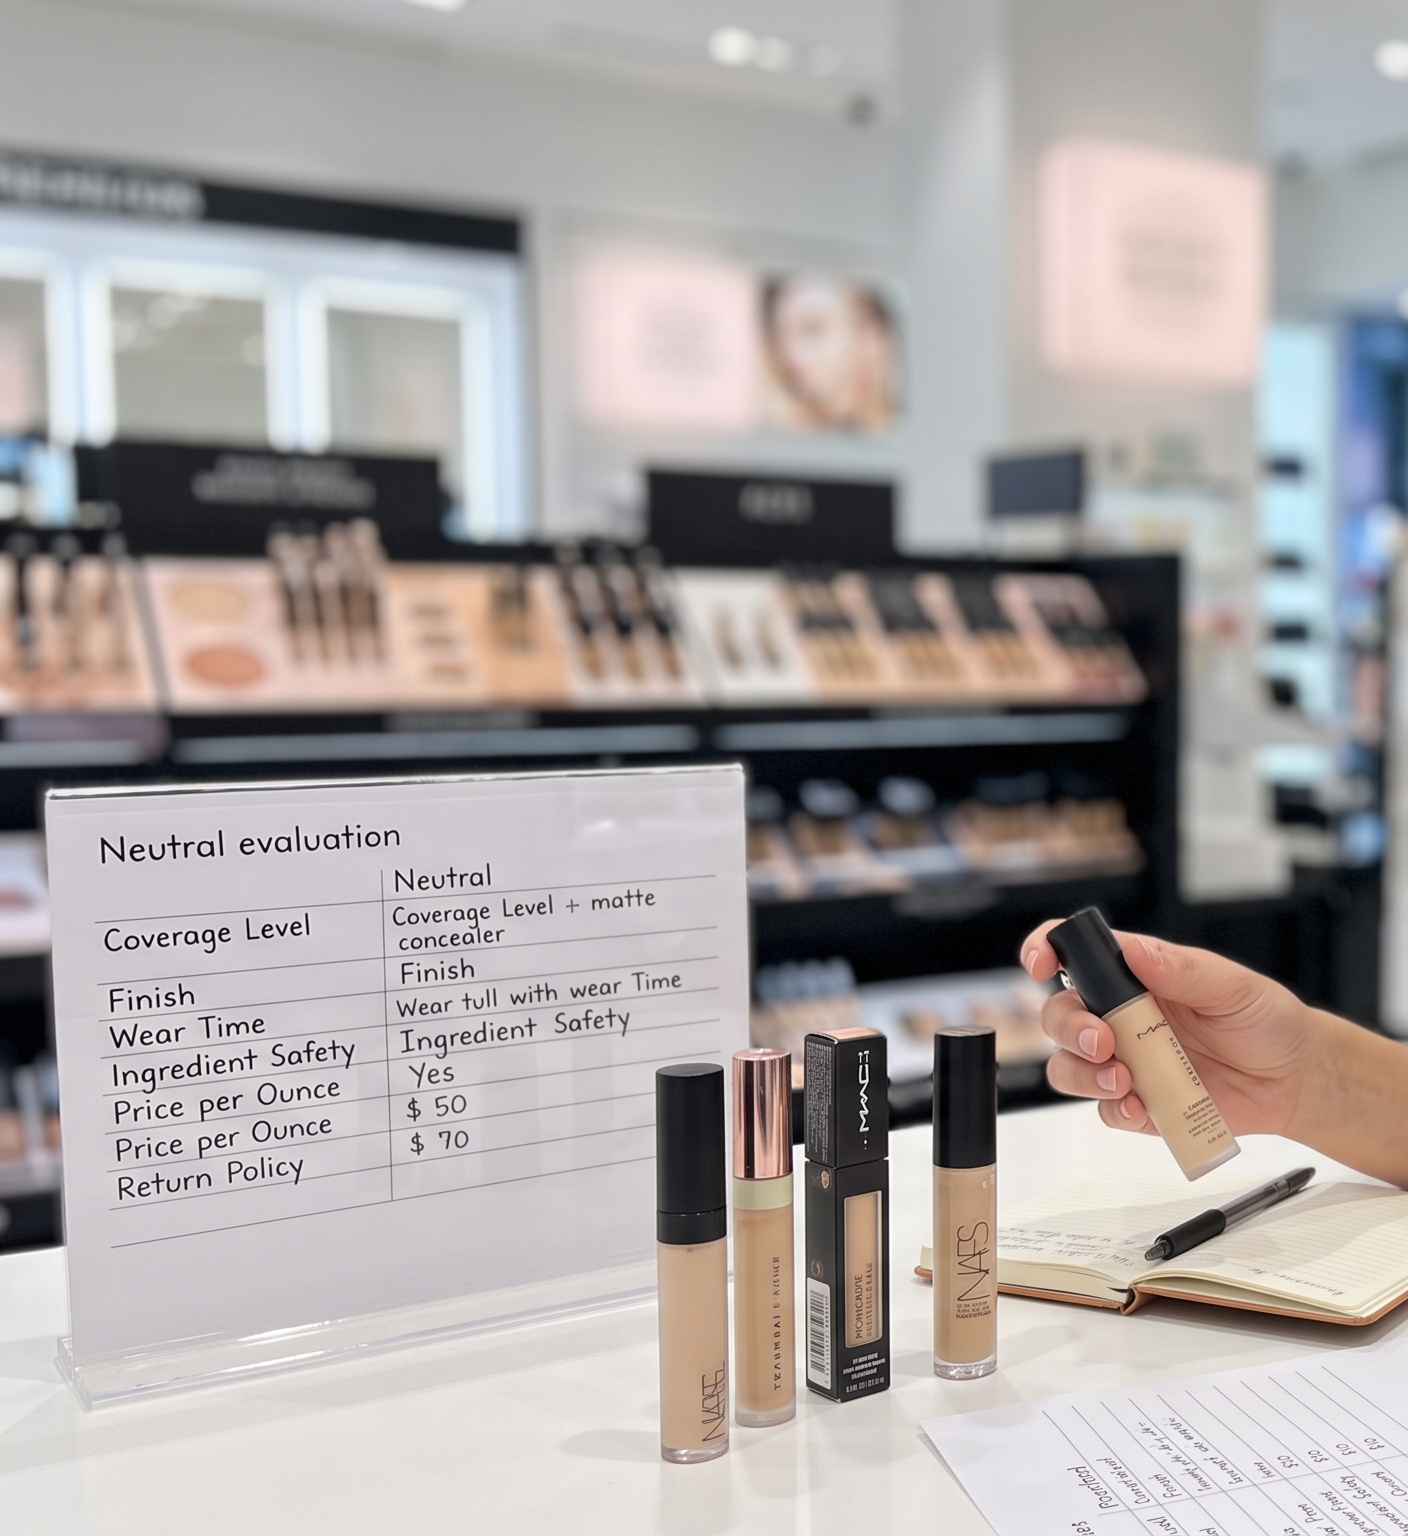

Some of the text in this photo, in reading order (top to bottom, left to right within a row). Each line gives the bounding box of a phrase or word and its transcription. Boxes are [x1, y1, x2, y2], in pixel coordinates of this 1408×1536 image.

[100, 824, 400, 864] Neutral evaluation
[394, 862, 491, 893] Neutral
[392, 889, 655, 930] Coverage Level + matte
[104, 912, 310, 954] Coverage Level
[399, 927, 505, 951] concealer
[401, 957, 475, 985] Finish
[109, 982, 195, 1013] Finish
[396, 998, 453, 1018] Wear
[510, 982, 558, 1006] with
[570, 981, 621, 999] wear
[631, 972, 681, 991] Time
[109, 1015, 266, 1049] Wear Time
[399, 1008, 630, 1060] Ingredient Safety
[113, 1039, 355, 1095] Ingredient Safety
[408, 1062, 455, 1089] Yes
[114, 1081, 341, 1125] Price per Ounce
[406, 1094, 467, 1122] $ 50
[115, 1118, 332, 1162] Price per Ounce
[410, 1130, 469, 1156] $ 70
[118, 1156, 304, 1201] Return Policy
